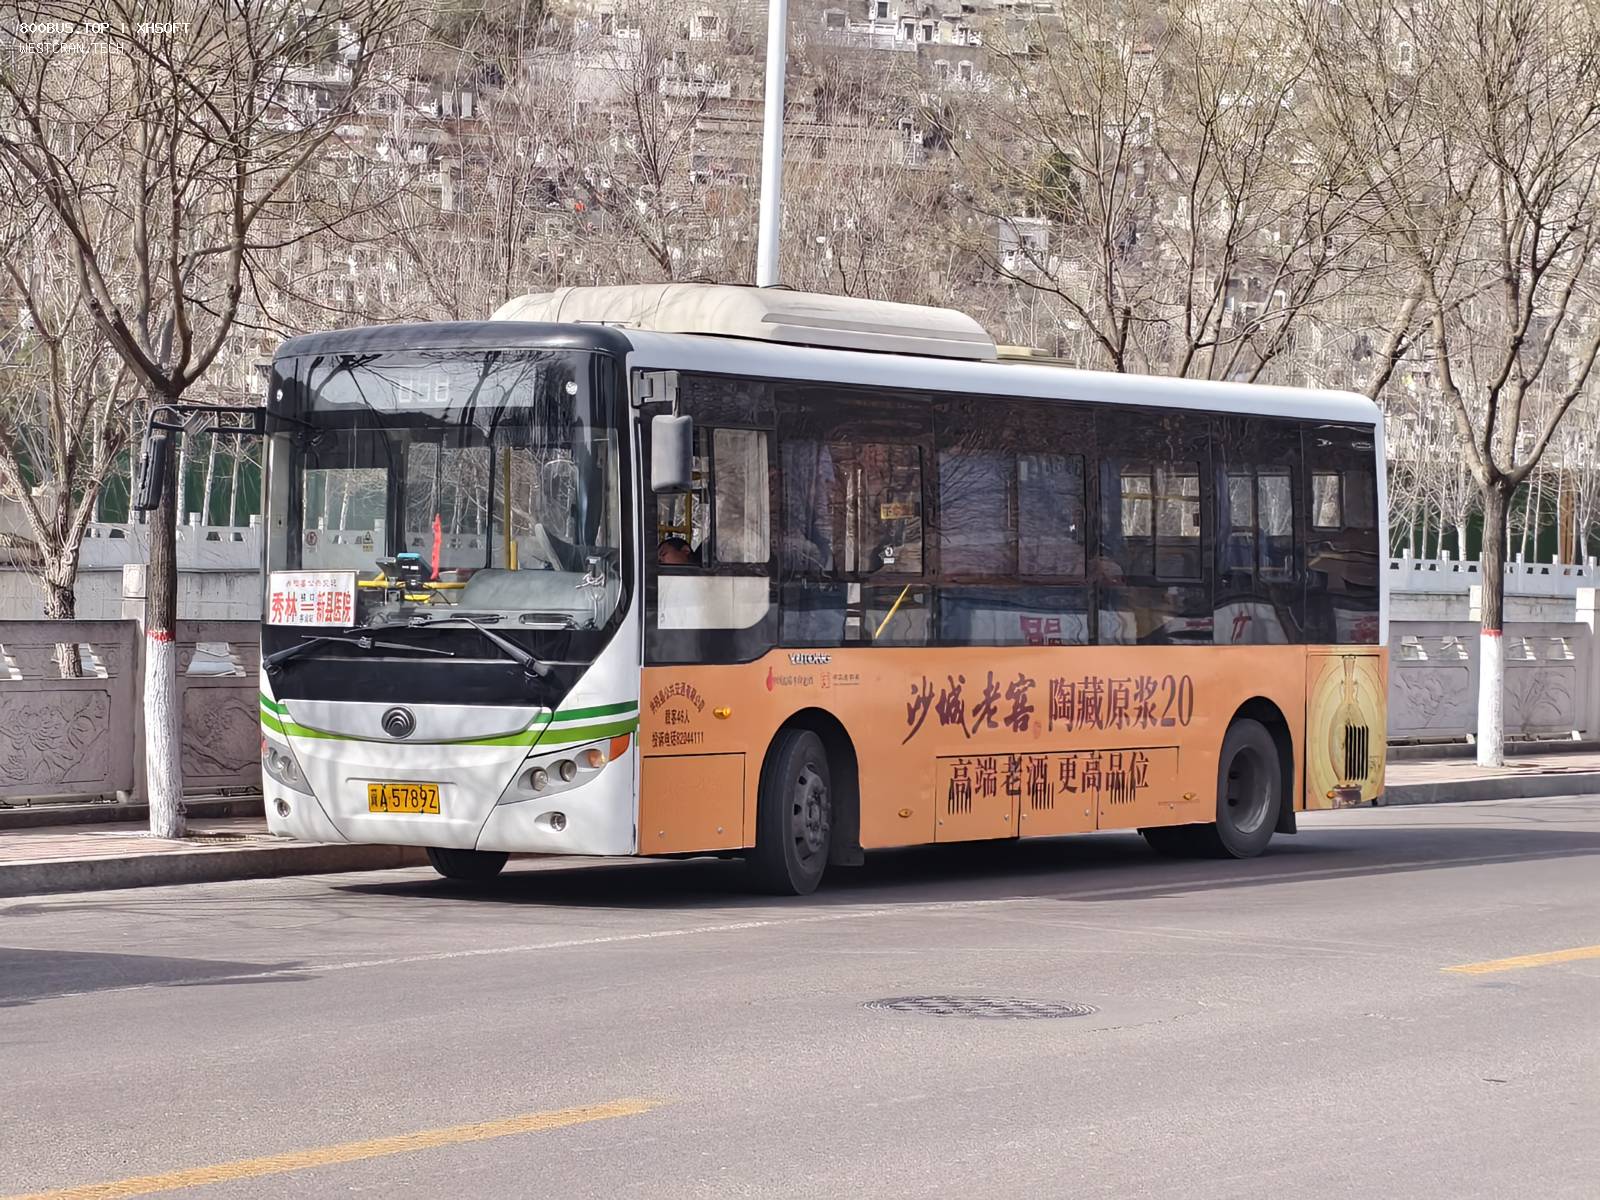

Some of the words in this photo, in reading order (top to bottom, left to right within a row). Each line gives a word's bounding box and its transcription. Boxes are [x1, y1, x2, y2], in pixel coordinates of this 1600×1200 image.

[271, 592, 298, 623] 秀林
[316, 591, 352, 623] 新县医院
[902, 671, 1036, 745] 沙城老窖
[1048, 674, 1194, 732] 陶藏原浆20
[949, 754, 1050, 798] 高端老酒
[1057, 751, 1149, 795] 更高品位
